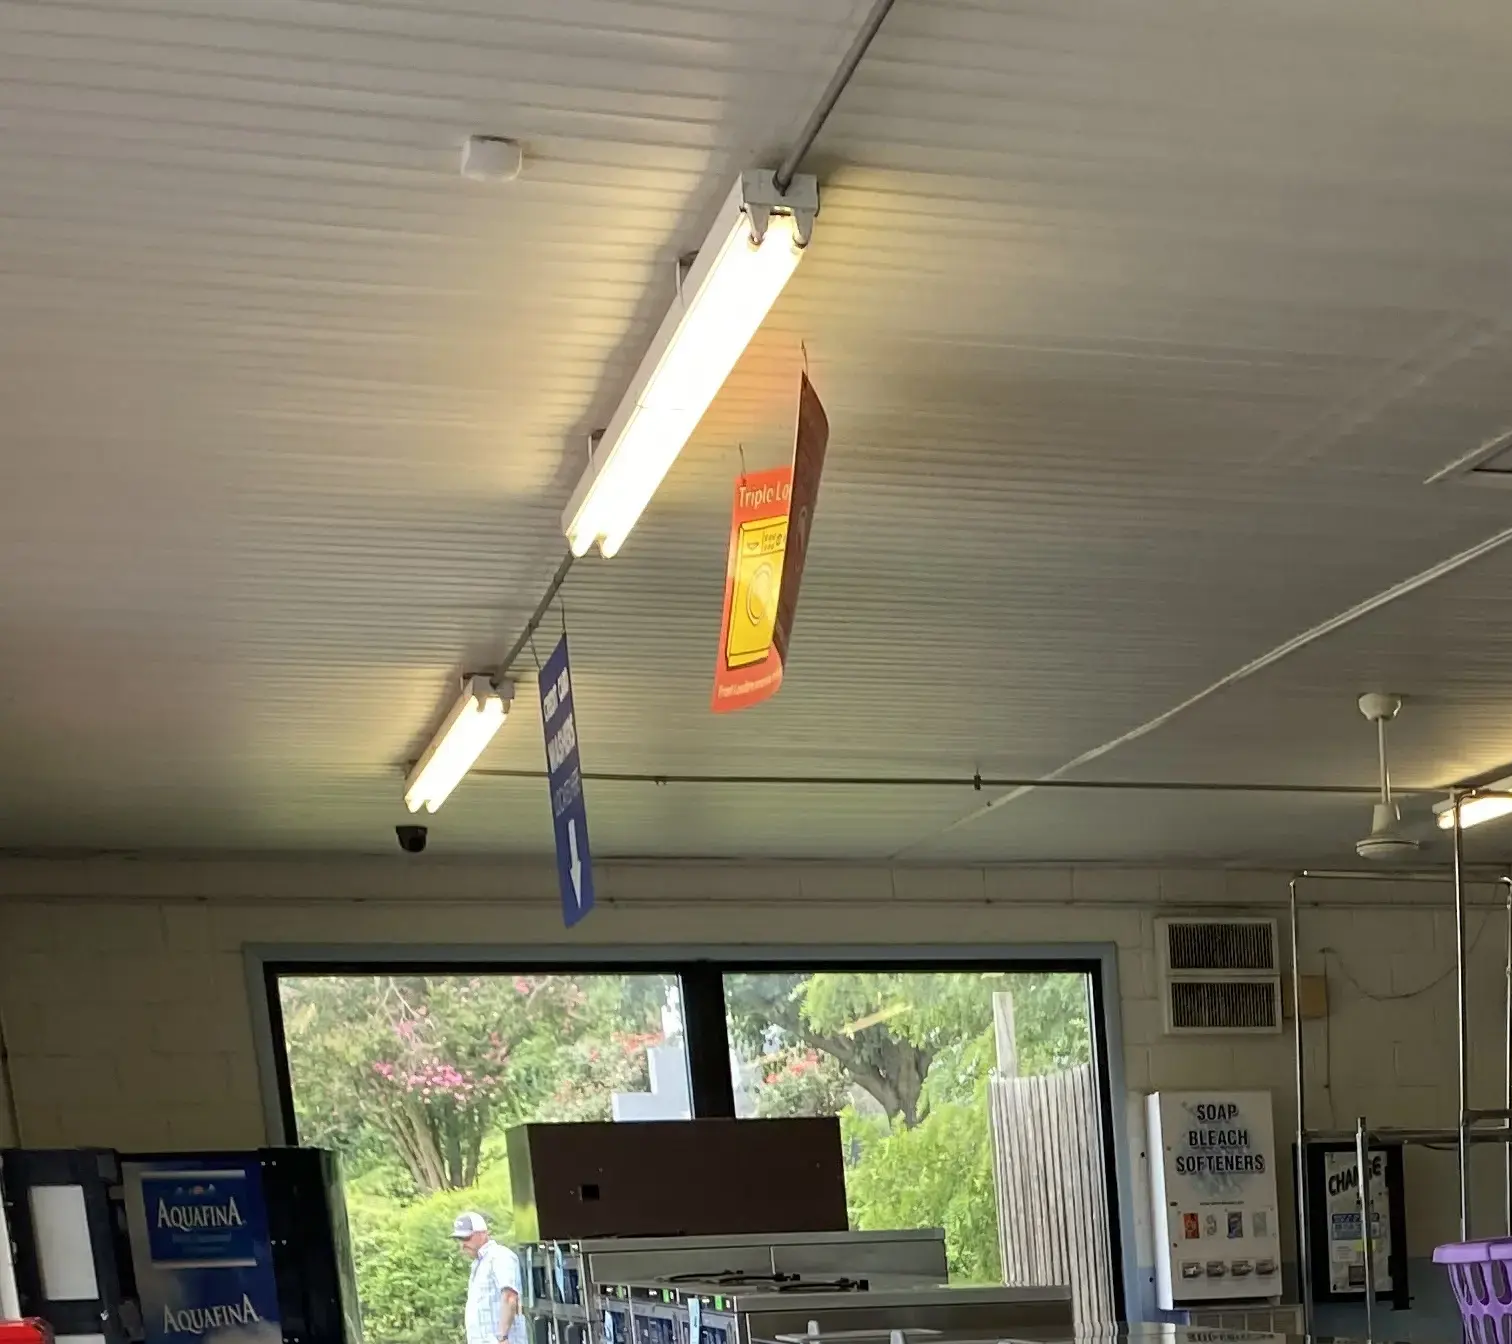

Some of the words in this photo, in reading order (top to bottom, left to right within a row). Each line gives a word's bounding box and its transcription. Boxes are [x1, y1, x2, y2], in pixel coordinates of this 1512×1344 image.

[738, 485, 774, 509] Triple
[775, 481, 791, 502] Lo
[1196, 1103, 1239, 1122] SOAP
[1188, 1129, 1249, 1148] BLEACH
[1176, 1154, 1266, 1173] SOFTENERS
[1328, 1156, 1383, 1197] CHAE
[157, 1196, 244, 1232] AQUAFINA
[163, 1292, 262, 1334] AQUAFINA
